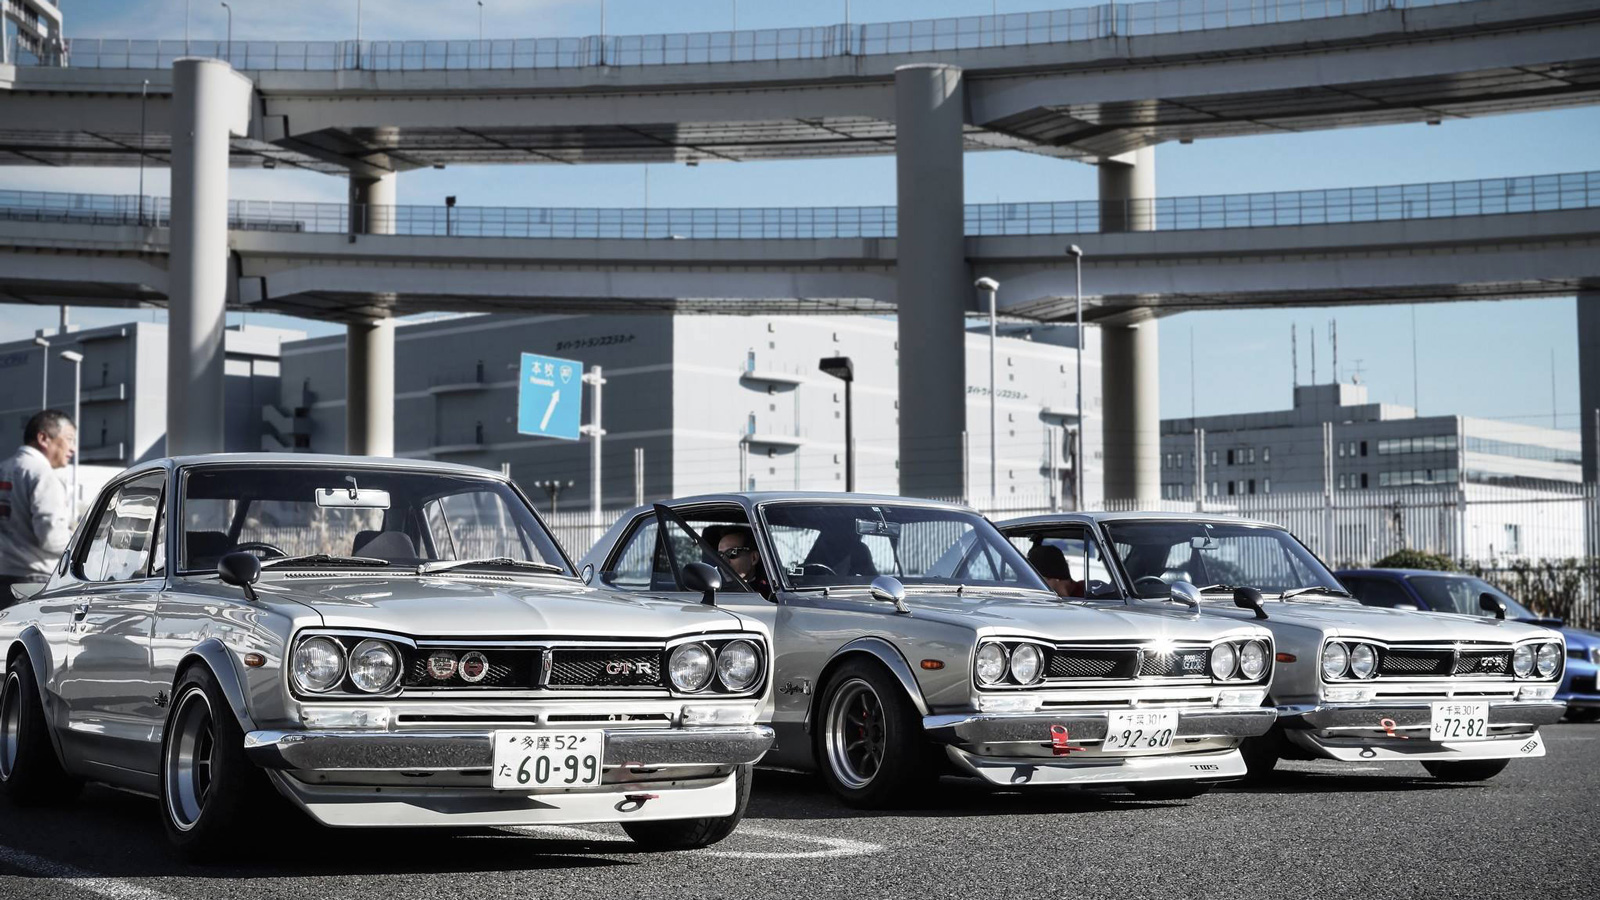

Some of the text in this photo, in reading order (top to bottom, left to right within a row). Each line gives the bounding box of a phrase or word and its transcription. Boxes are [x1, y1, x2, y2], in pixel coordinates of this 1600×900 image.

[1118, 728, 1172, 748] 92-60
[1443, 718, 1485, 738] 72-82
[520, 735, 578, 751] 多摩 52
[499, 755, 597, 784] た 60-99
